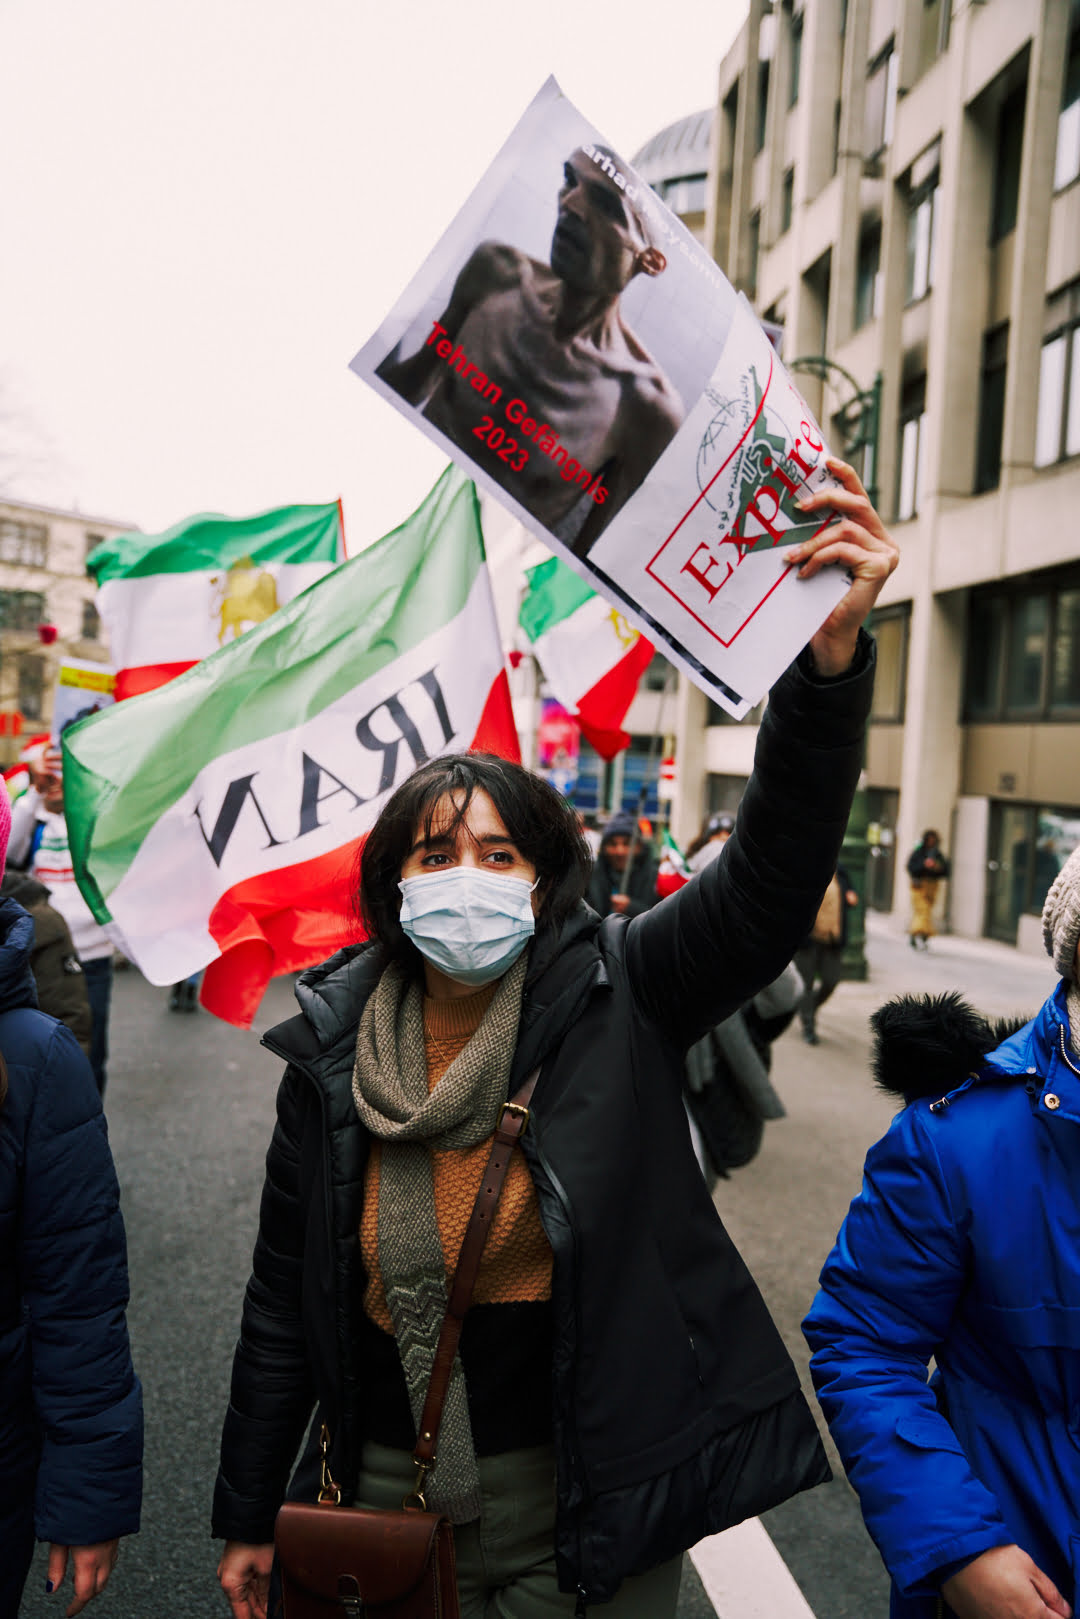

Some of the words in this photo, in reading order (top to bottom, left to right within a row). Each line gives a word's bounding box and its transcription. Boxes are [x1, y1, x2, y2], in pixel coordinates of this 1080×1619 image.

[424, 320, 503, 405] Tehran
[505, 398, 610, 505] Gefängnis
[472, 415, 530, 472] 2023
